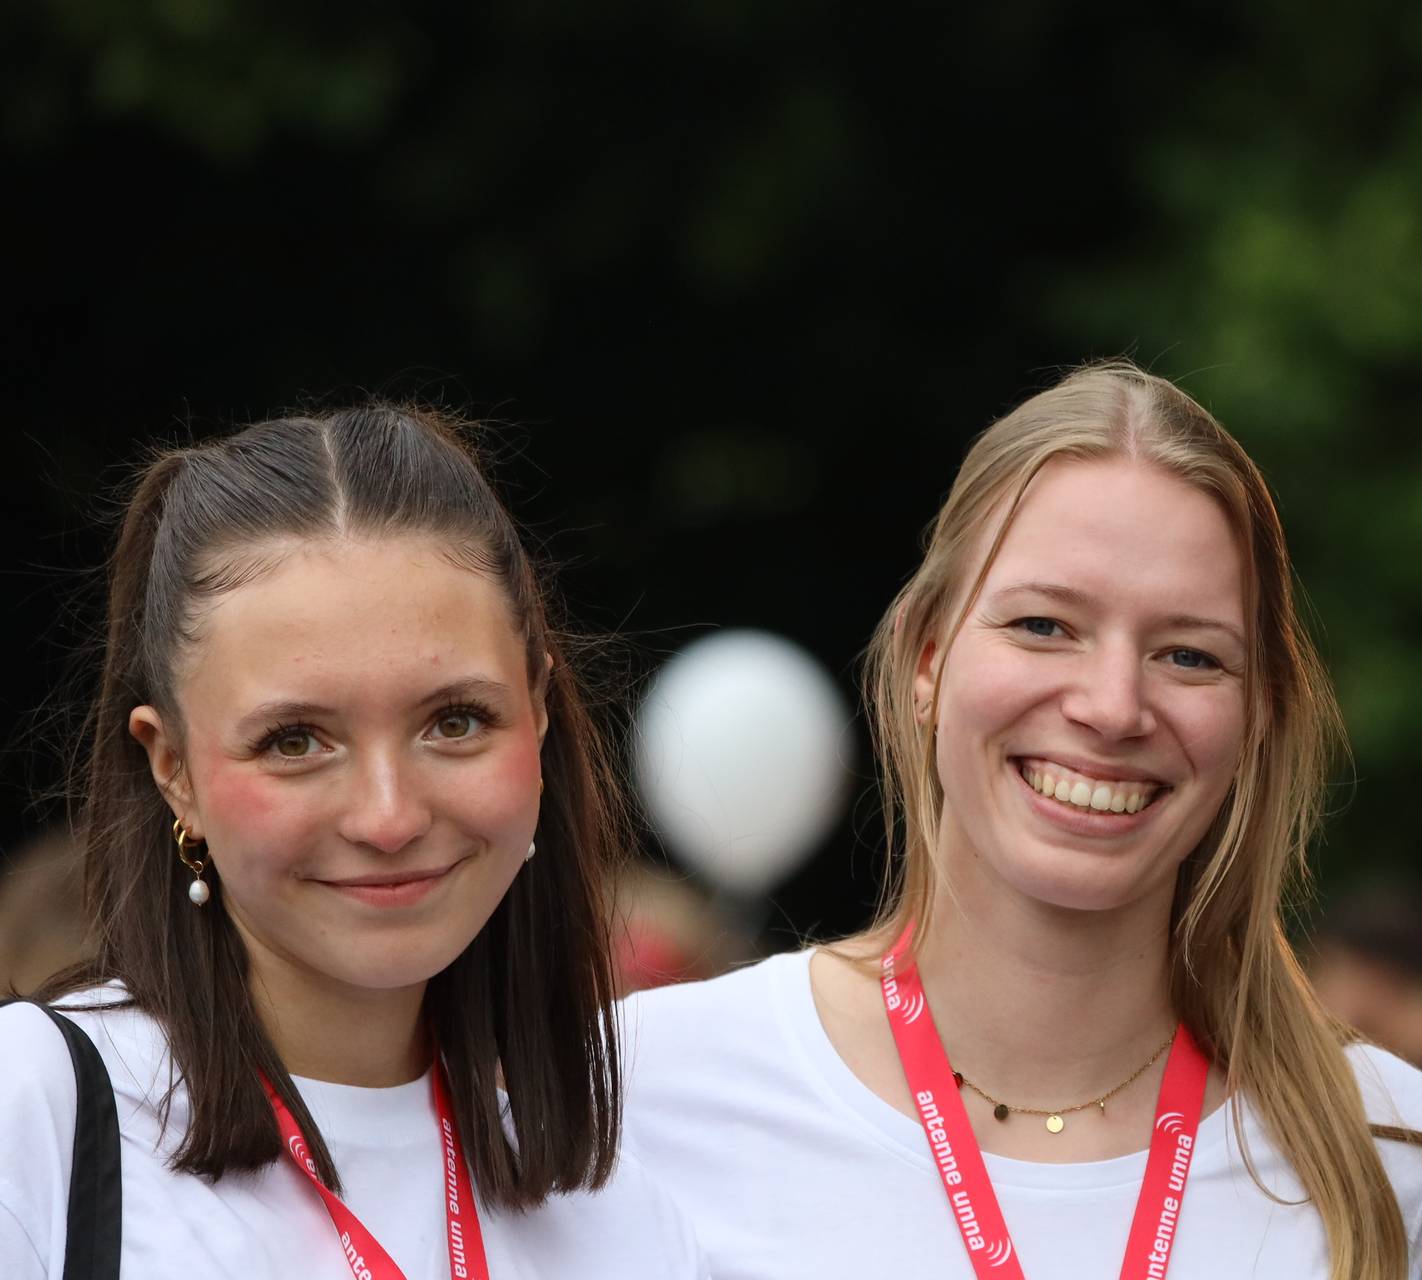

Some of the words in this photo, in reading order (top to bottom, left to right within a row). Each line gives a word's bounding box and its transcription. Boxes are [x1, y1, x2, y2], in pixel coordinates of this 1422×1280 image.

[442, 1117, 460, 1215] antenne
[916, 1090, 963, 1186] antenne
[952, 1191, 985, 1251] unna
[1146, 1196, 1179, 1280] ntenne
[1168, 1133, 1193, 1192] unna
[450, 1220, 467, 1278] unna
